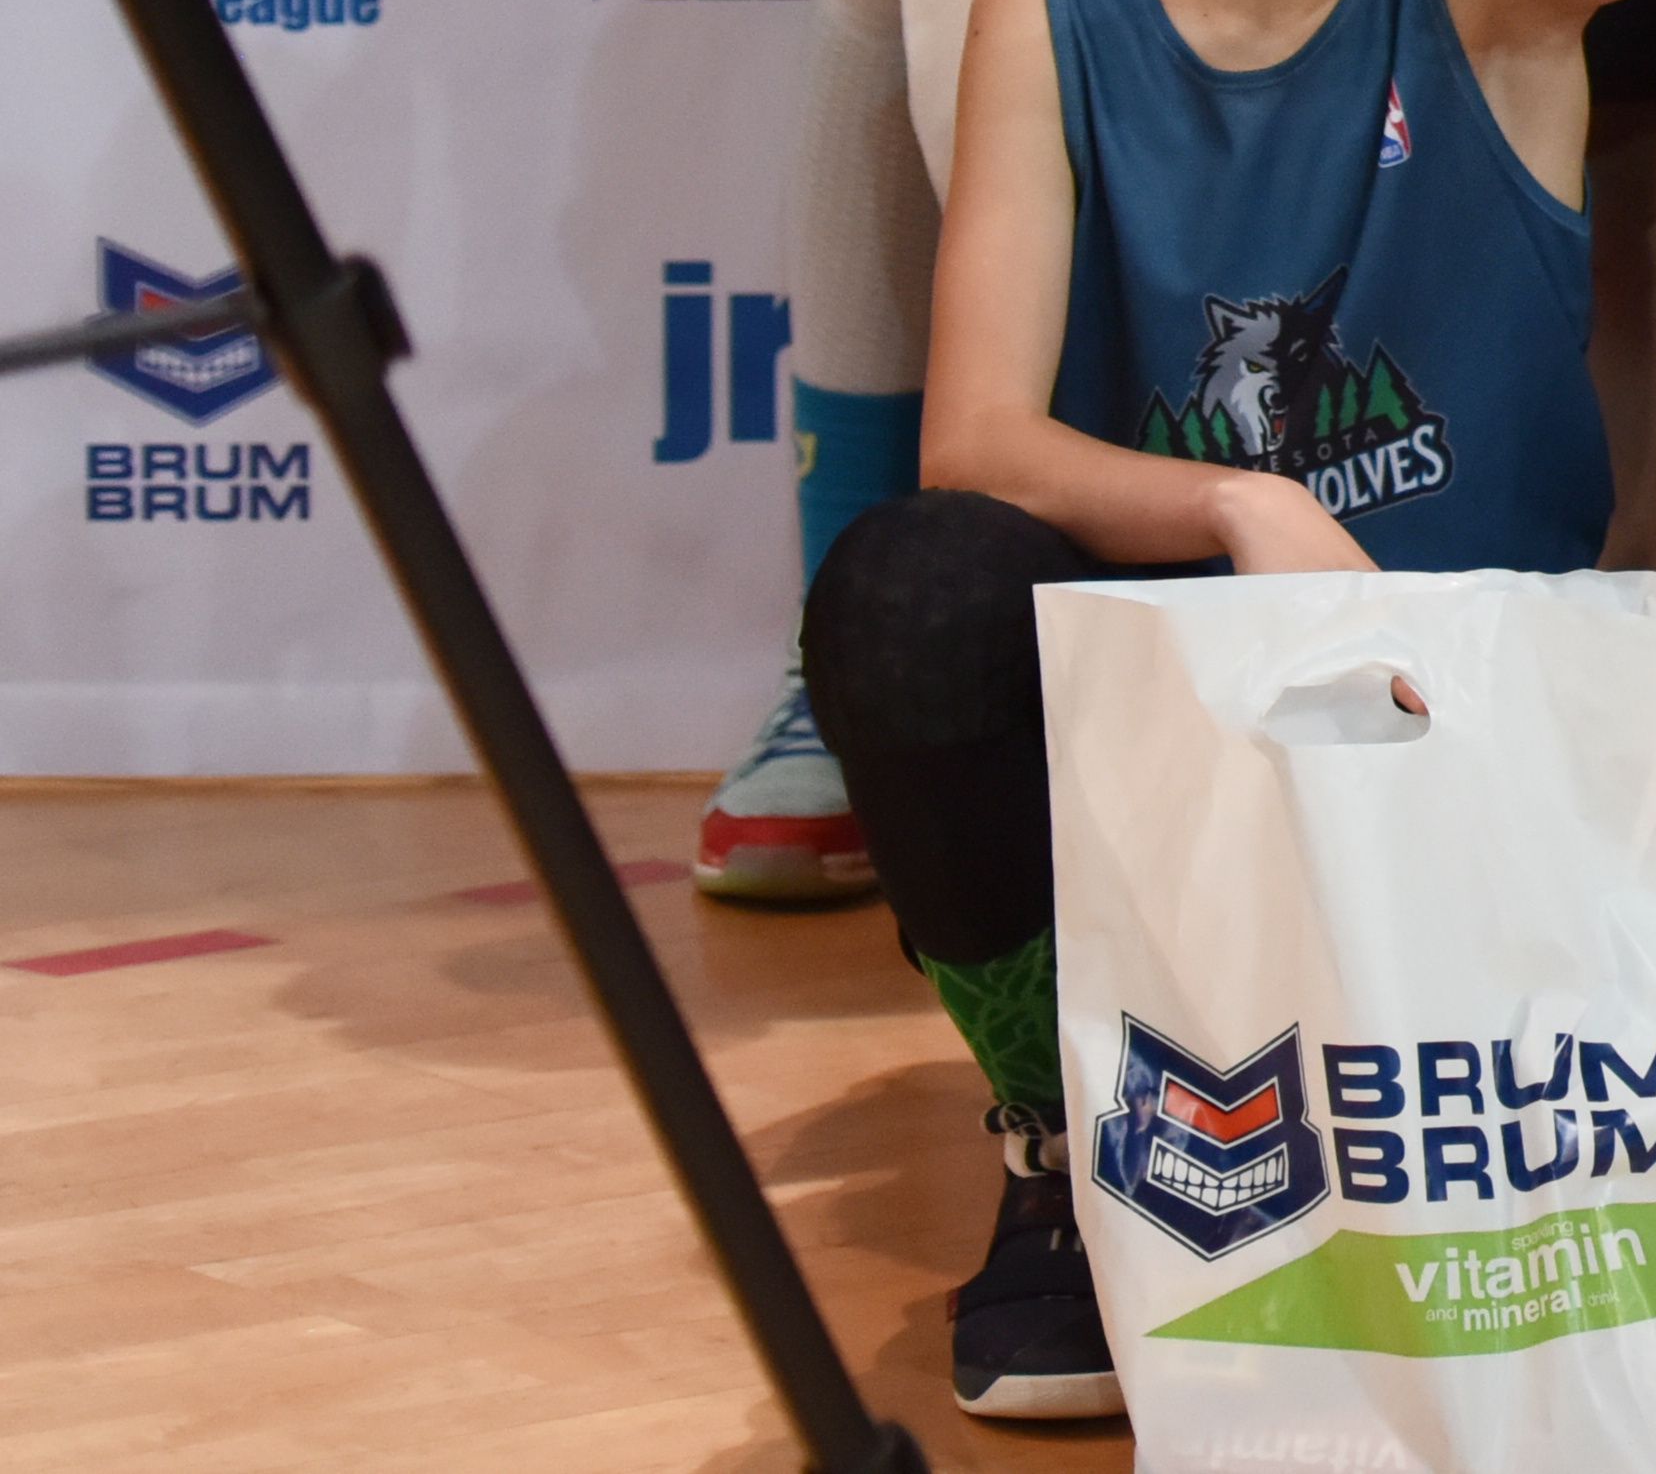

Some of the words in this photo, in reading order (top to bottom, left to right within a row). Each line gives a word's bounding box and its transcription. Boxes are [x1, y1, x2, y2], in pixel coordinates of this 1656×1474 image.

[653, 261, 792, 463] jr
[86, 444, 312, 480] BRUM
[86, 485, 312, 522] BRUM
[1395, 1223, 1647, 1303] vitamin
[1426, 1306, 1457, 1322] and
[1463, 1279, 1582, 1332] mineral
